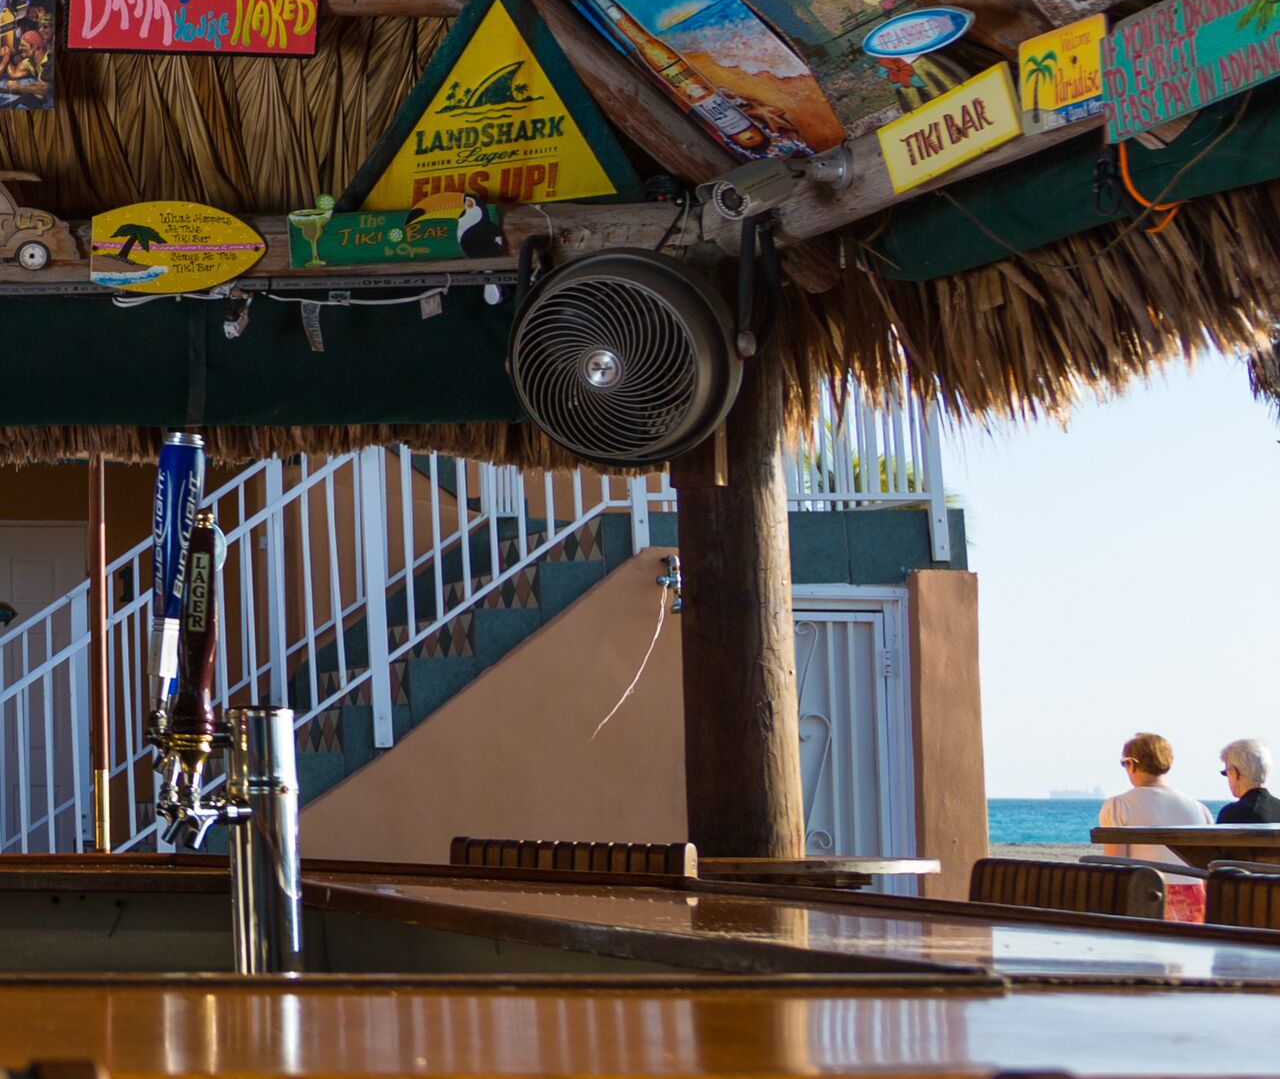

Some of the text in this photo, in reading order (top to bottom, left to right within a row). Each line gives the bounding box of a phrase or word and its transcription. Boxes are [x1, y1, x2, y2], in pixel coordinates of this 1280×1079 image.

[1102, 32, 1118, 69] IF
[1105, 30, 1197, 99] TO FORGET
[1054, 68, 1100, 105] Paradise
[1161, 72, 1192, 118] PAY
[1196, 63, 1216, 102] IN
[415, 116, 565, 155] LANDSHARK
[900, 97, 993, 166] TIKI BAR
[417, 147, 558, 168] PREMIUM Lager QUALITY
[499, 162, 559, 202] UP!
[338, 225, 449, 246] TIKI BAR
[359, 214, 386, 228] The
[172, 471, 198, 598] BUD LIGHT
[190, 554, 208, 630] LAGER
